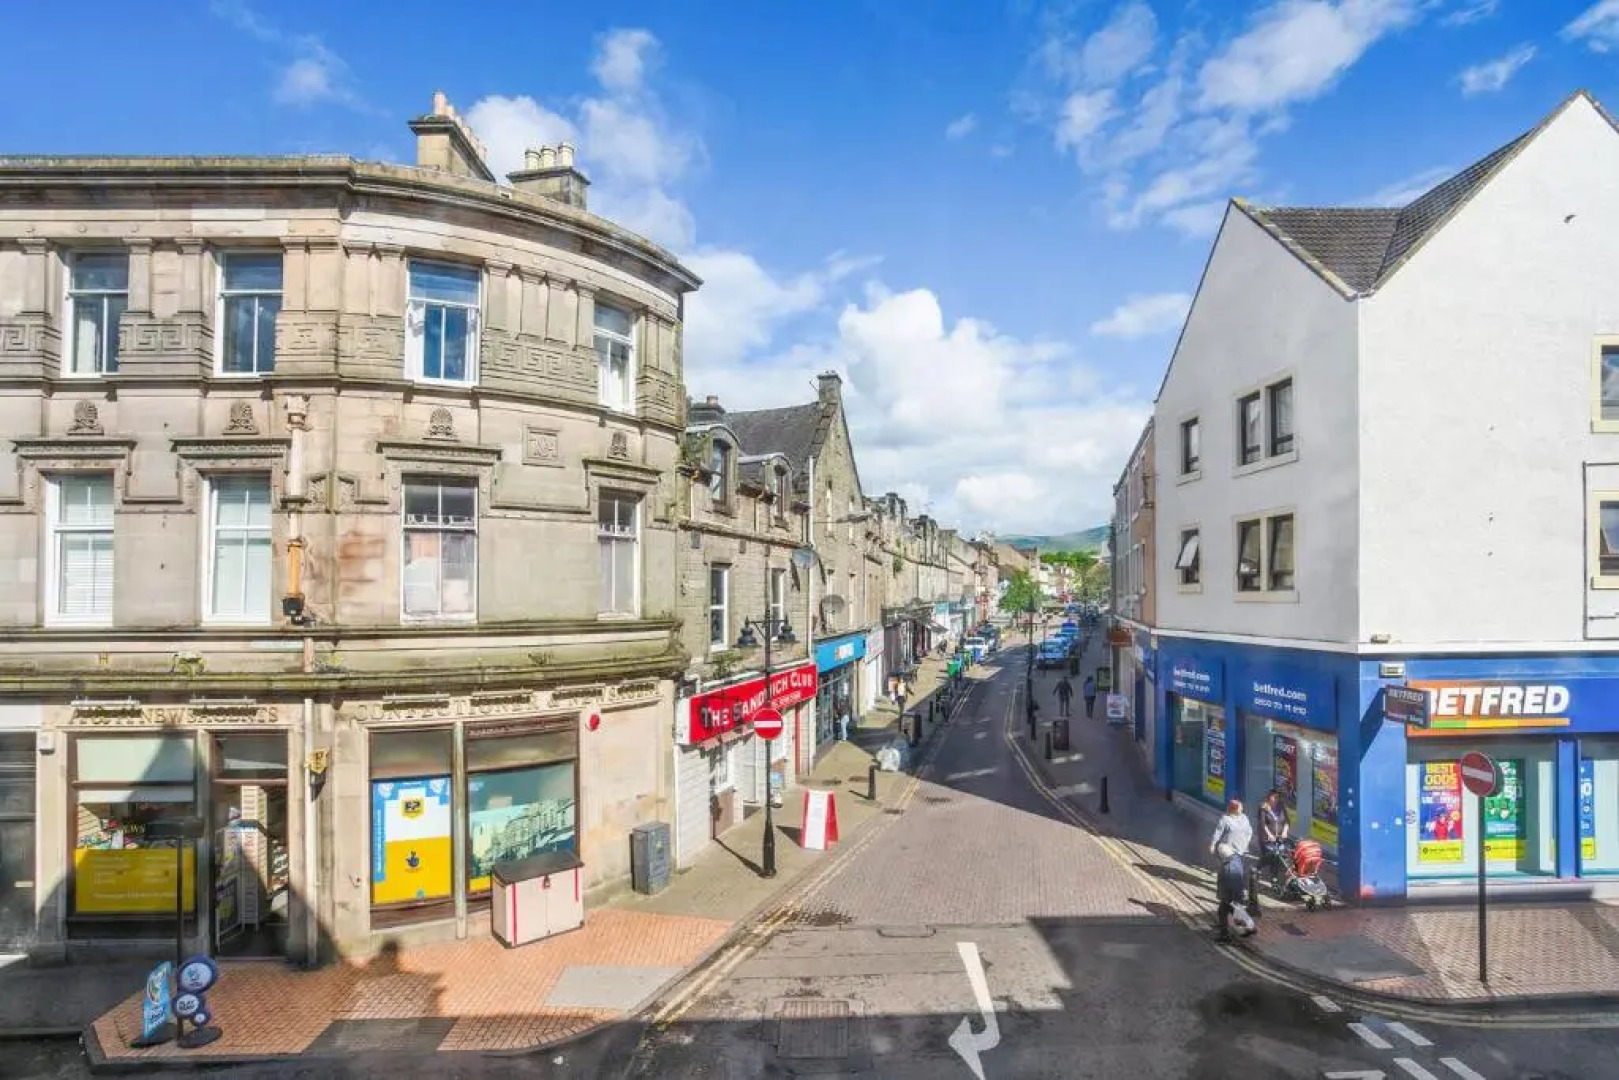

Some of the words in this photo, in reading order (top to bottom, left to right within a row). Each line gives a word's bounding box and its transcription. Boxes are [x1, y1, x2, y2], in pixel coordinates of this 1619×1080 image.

[701, 706, 730, 728] THE
[790, 671, 813, 688] CLUB
[1253, 682, 1307, 701] betfred.com
